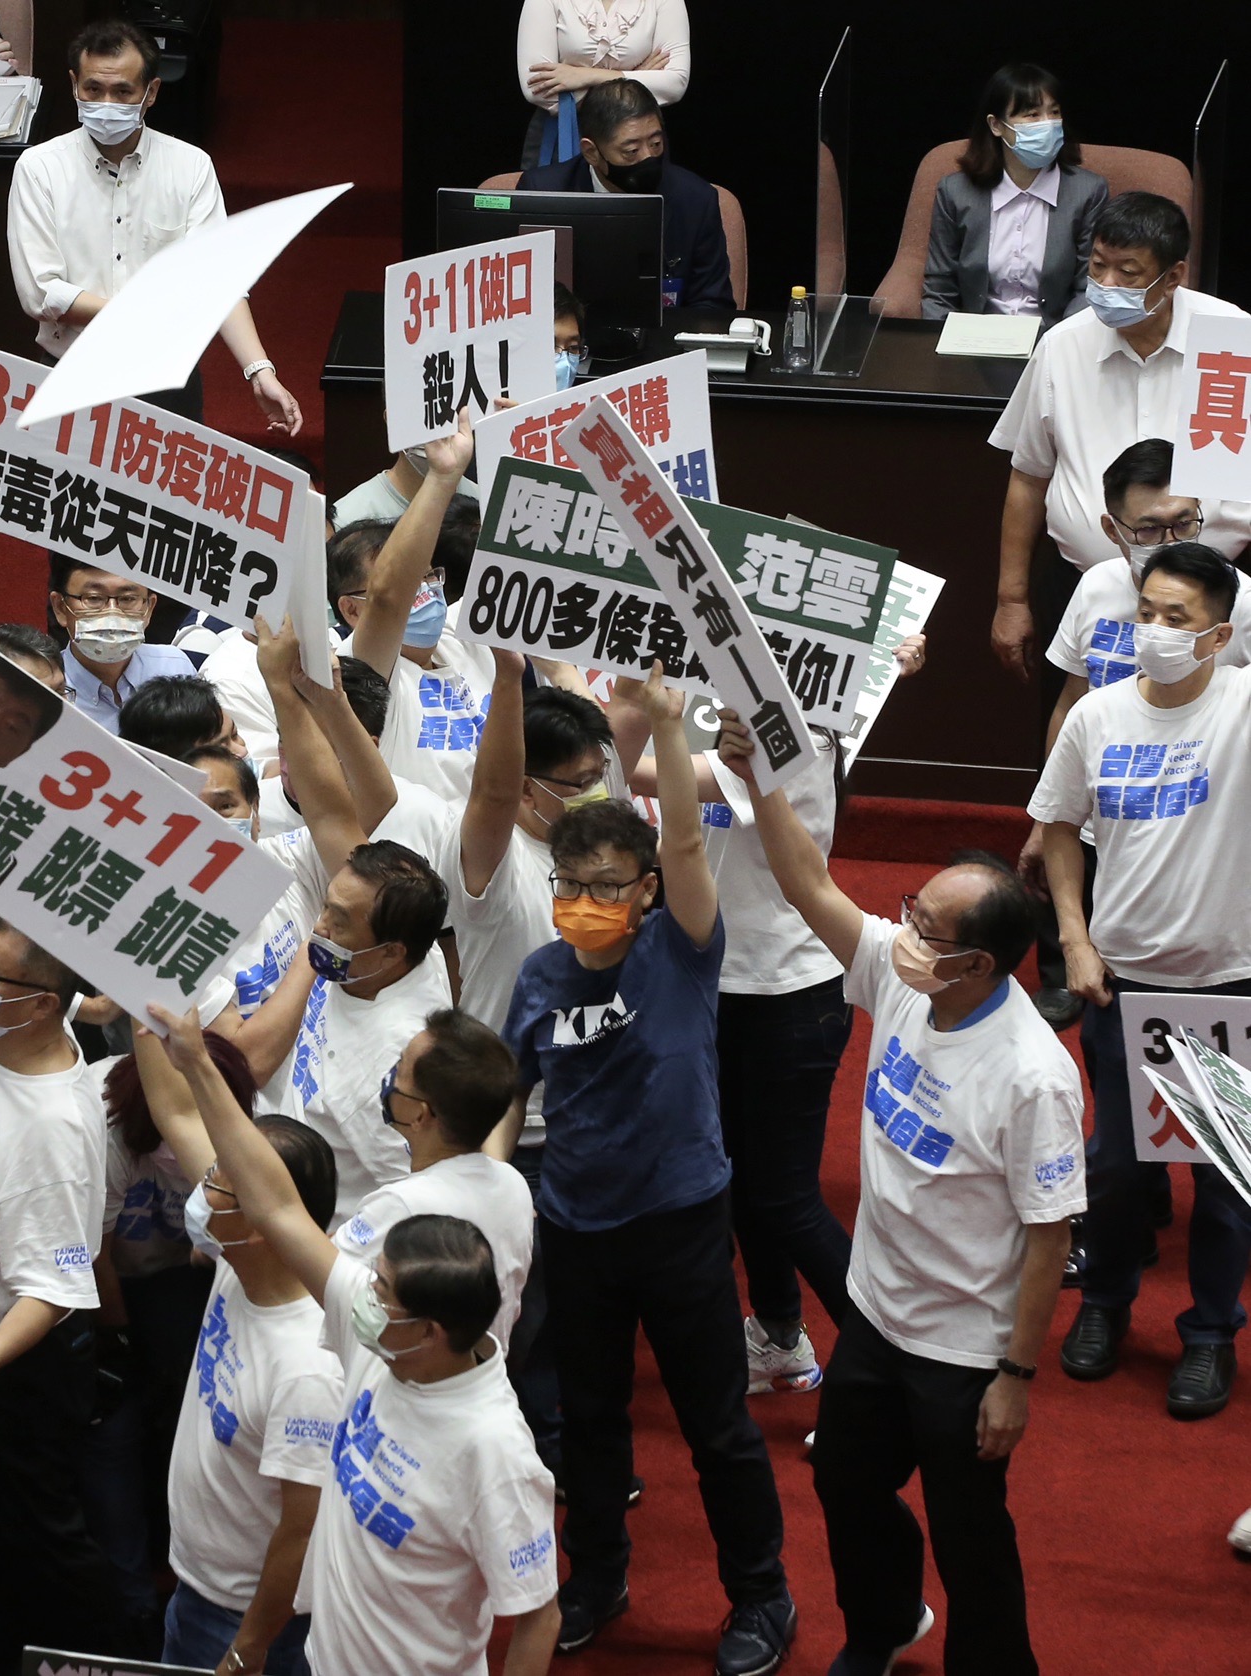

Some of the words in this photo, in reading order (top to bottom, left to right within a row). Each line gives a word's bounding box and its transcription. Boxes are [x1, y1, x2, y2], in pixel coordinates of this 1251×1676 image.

[403, 249, 532, 345] 3+11破口
[423, 340, 509, 430] 殺人!
[494, 474, 709, 568] 陳時
[734, 532, 880, 630] 范雲
[579, 413, 802, 772] 真相只有一個
[39, 750, 245, 894] 3+11
[17, 825, 147, 935] 跳票
[114, 885, 241, 997] 卸責
[387, 1438, 421, 1470] Taiwan
